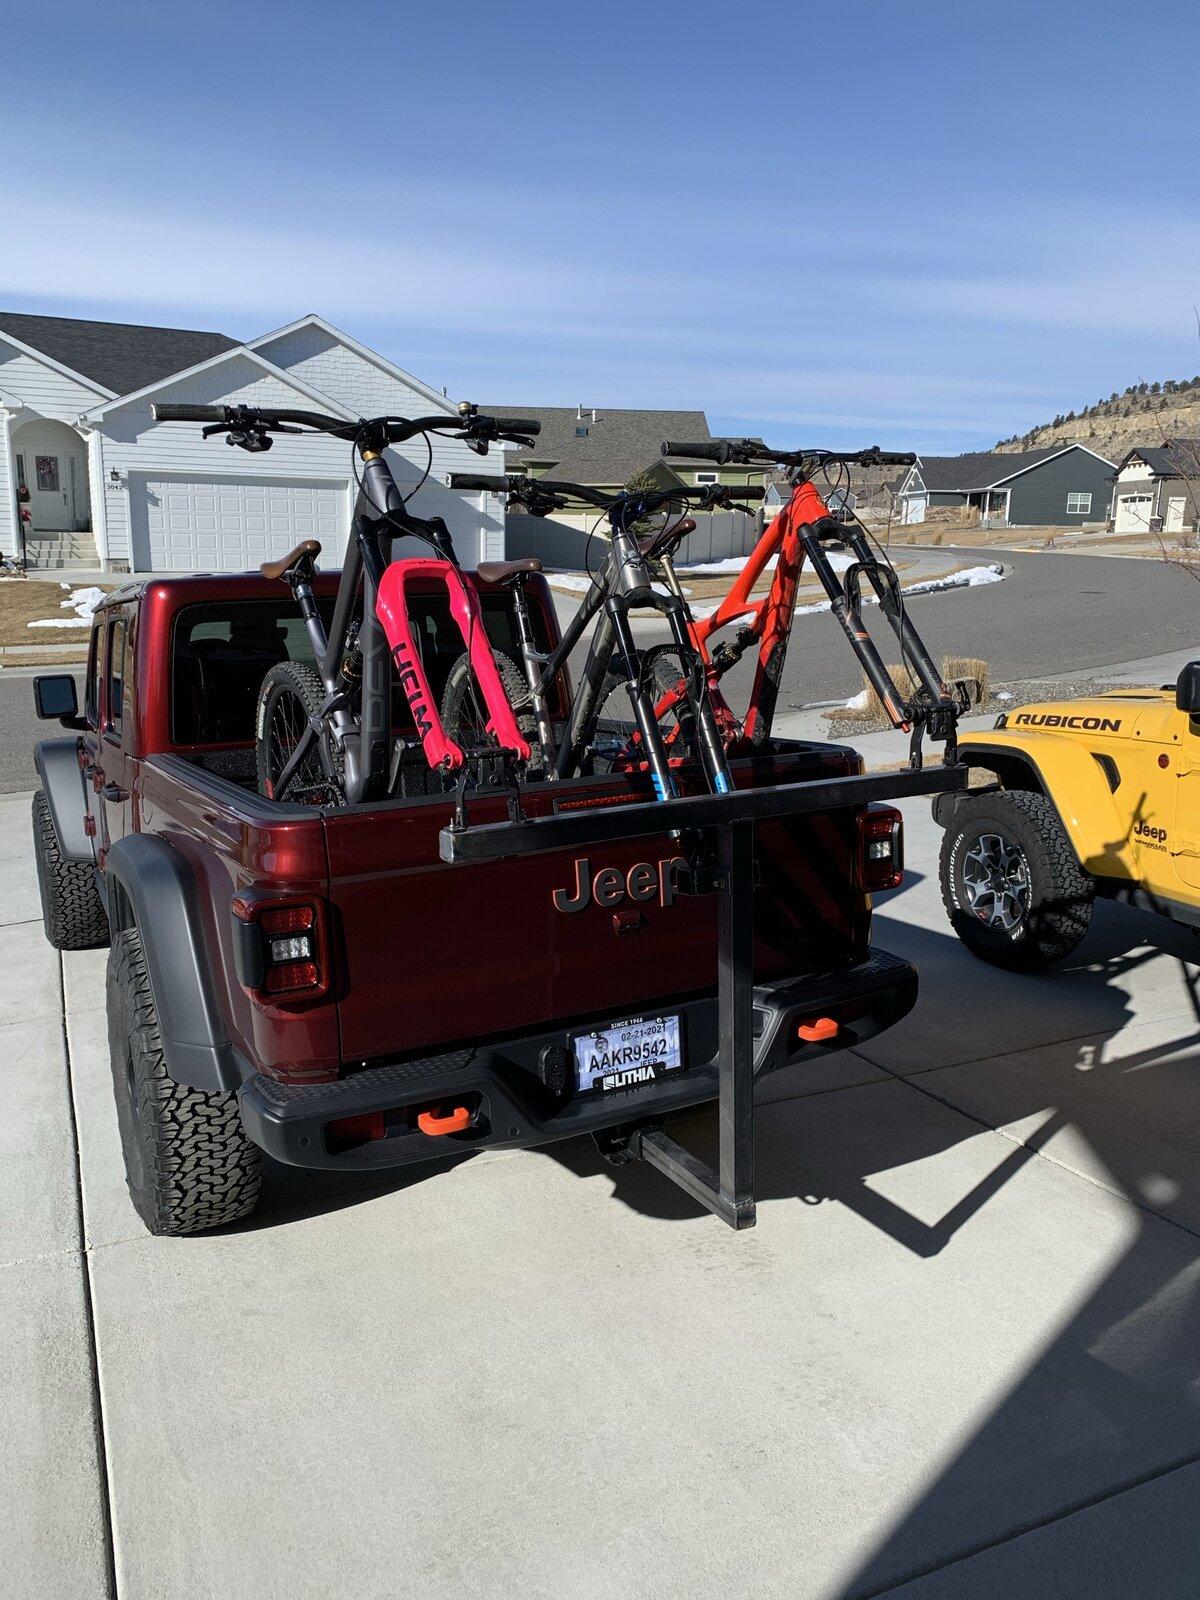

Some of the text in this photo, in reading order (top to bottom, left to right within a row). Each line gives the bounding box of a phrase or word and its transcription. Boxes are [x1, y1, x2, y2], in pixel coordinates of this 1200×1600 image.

[1015, 713, 1122, 732] RUBICON
[1133, 819, 1168, 843] Jeep
[552, 856, 690, 913] Jeep
[610, 1020, 628, 1029] SINCE
[621, 1024, 666, 1041] 02-21-2021
[589, 1039, 667, 1073] AAKR9542
[614, 1066, 655, 1087] LITHIA
